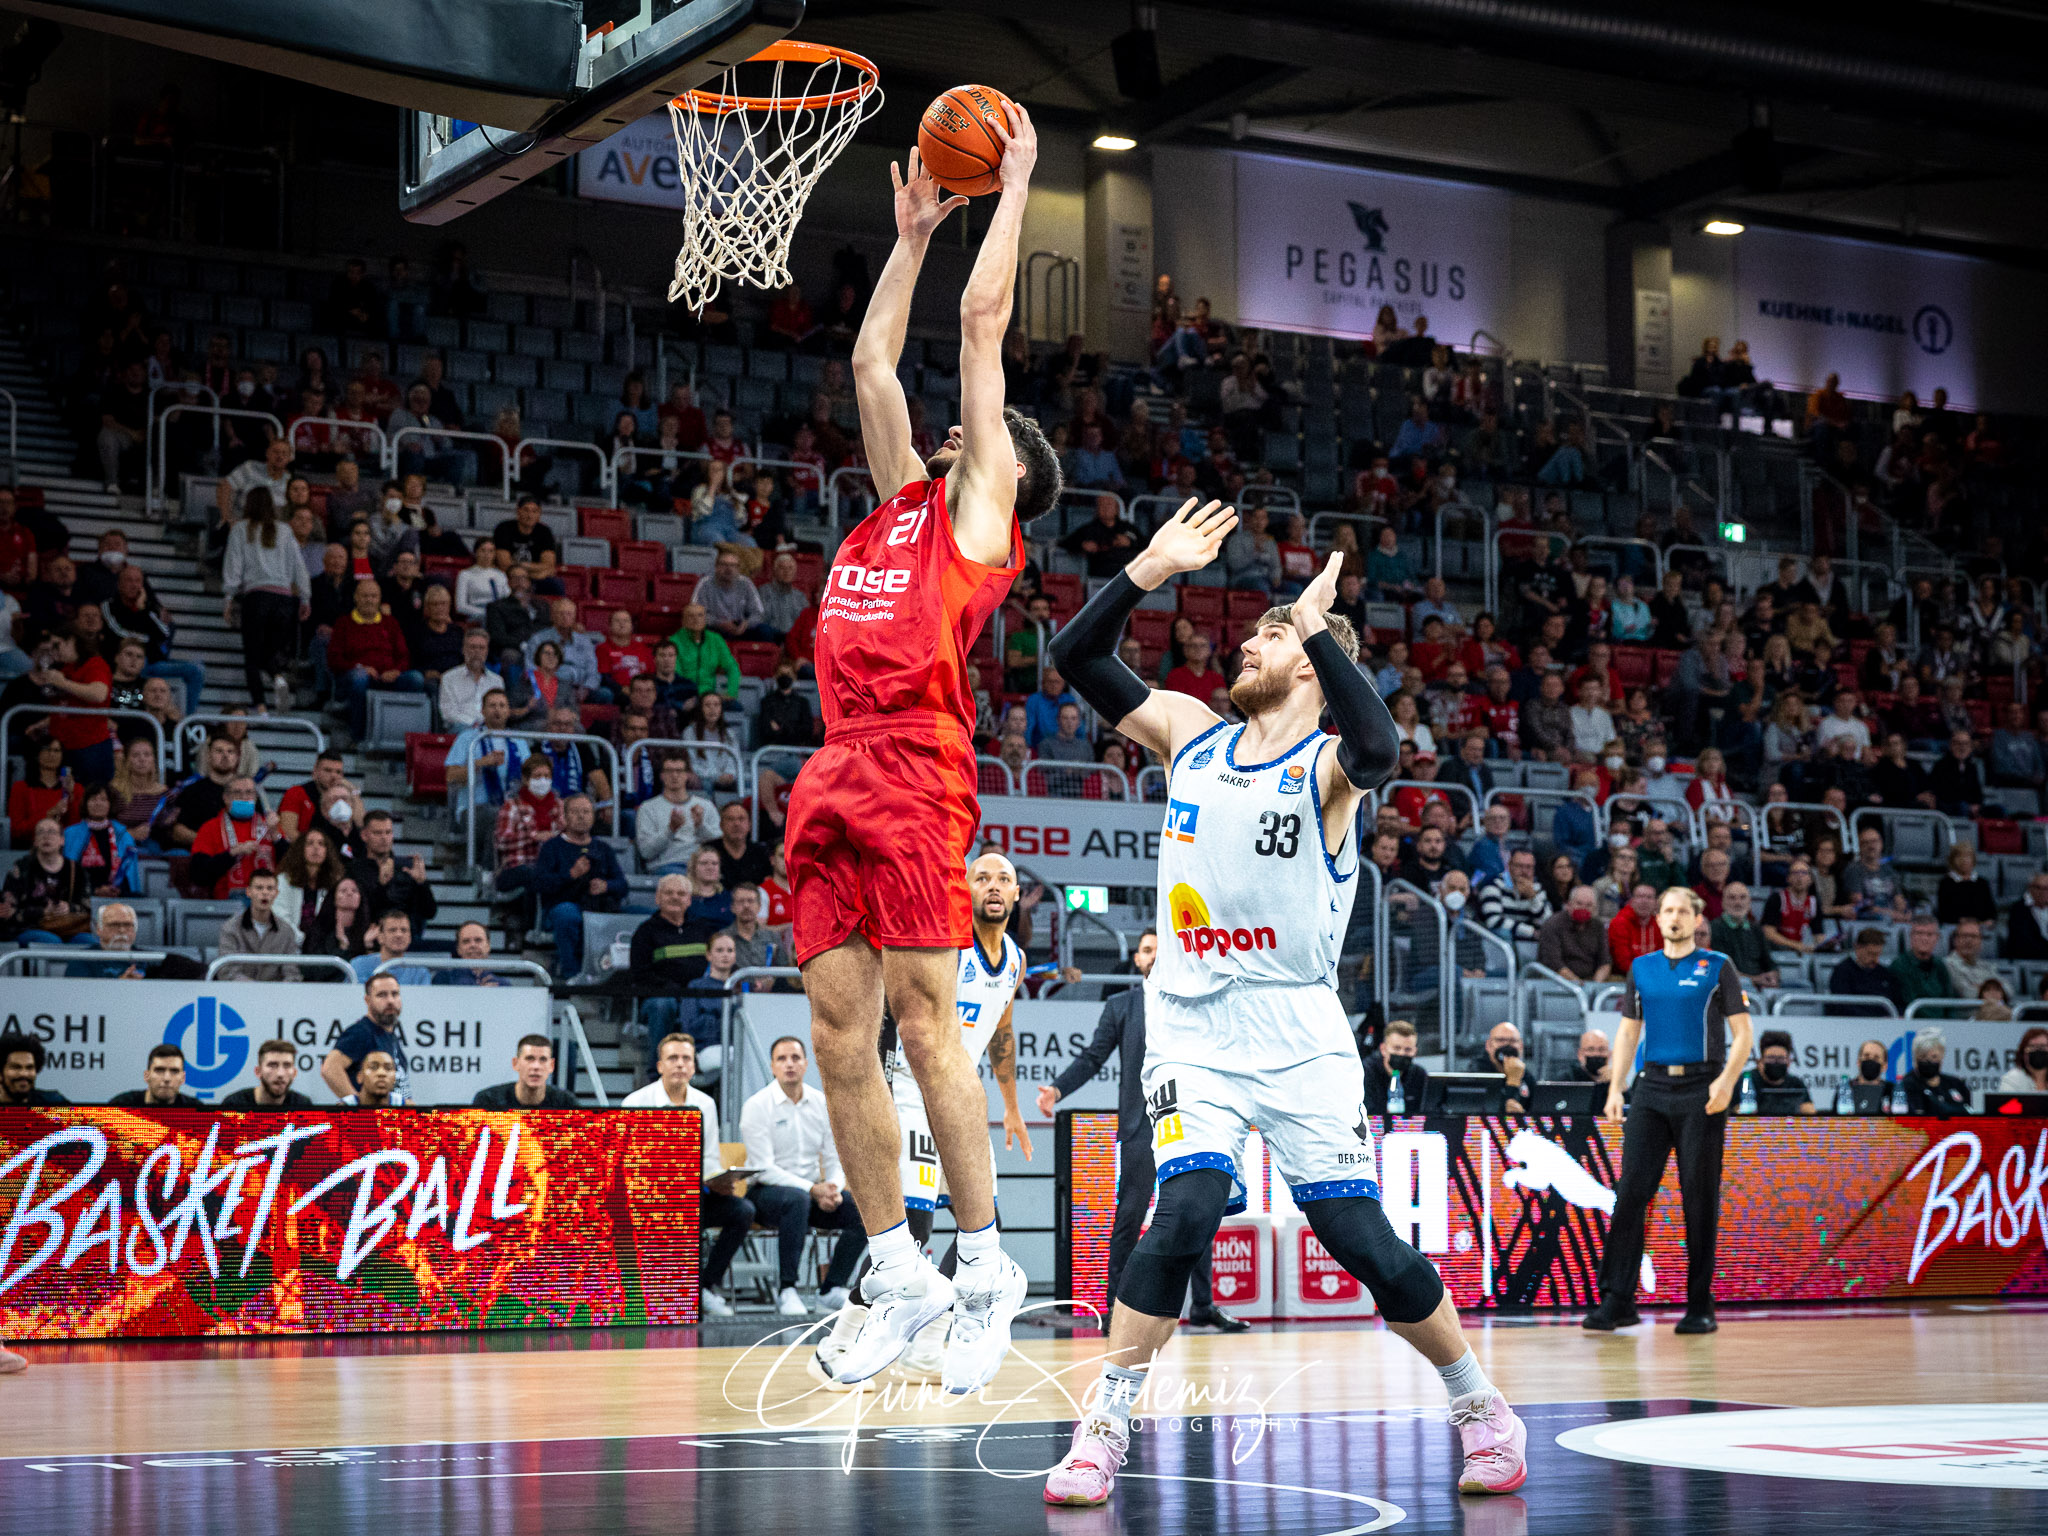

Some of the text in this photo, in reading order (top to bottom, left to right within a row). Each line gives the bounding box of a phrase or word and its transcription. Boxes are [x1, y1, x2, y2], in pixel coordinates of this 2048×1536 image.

[1286, 243, 1466, 301] PEGASUS
[887, 507, 928, 546] 21
[862, 598, 896, 609] Partner
[1217, 772, 1251, 788] HAKRO
[1082, 829, 1161, 859] ARE
[1255, 810, 1300, 859] 33
[1338, 1153, 1355, 1164] DER
